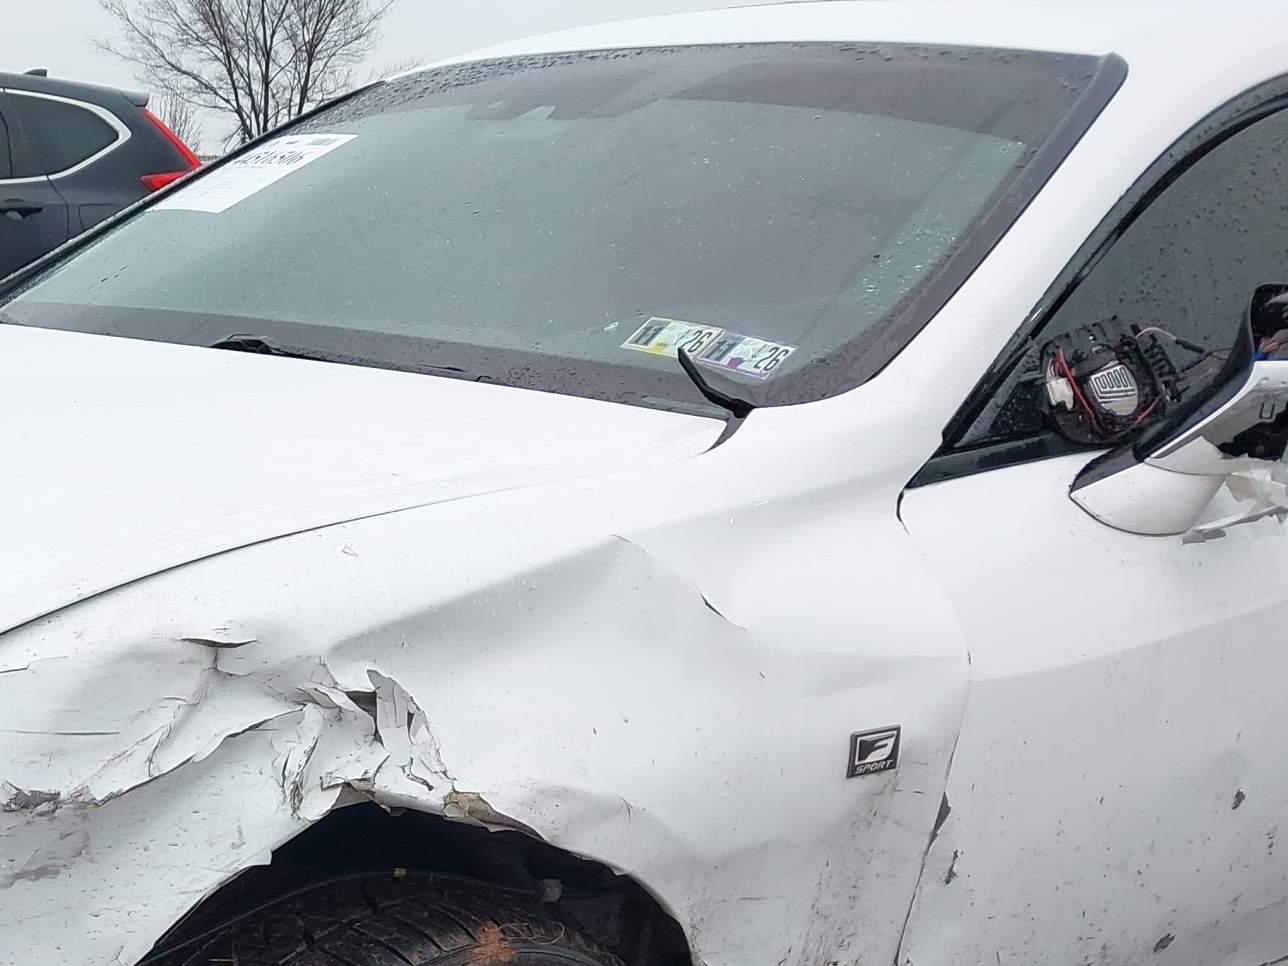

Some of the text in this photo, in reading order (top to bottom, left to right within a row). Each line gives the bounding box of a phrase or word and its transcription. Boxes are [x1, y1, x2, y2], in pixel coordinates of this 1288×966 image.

[680, 329, 712, 354] 26
[754, 346, 790, 372] 26
[855, 760, 893, 775] SPORT
